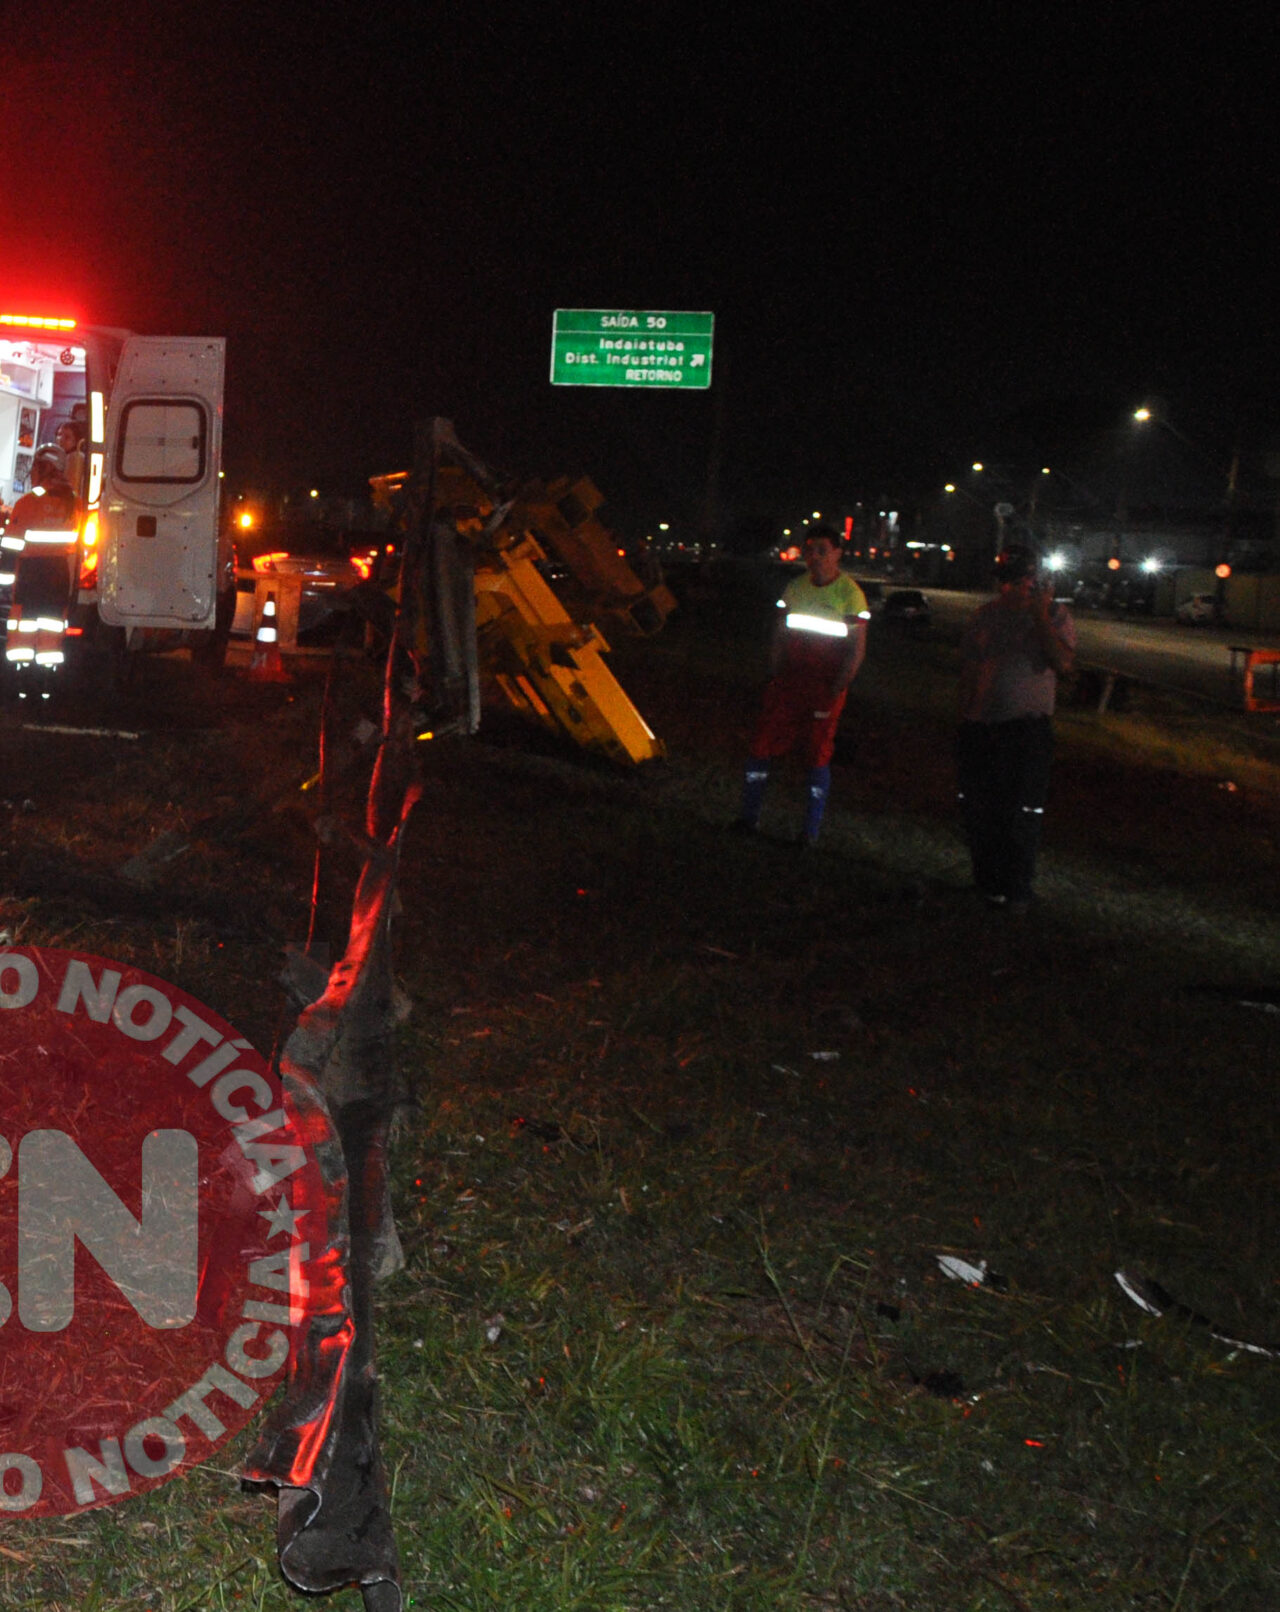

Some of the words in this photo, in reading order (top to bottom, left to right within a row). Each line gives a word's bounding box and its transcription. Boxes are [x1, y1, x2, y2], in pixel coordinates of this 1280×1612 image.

[601, 313, 638, 327] SAÍDA
[646, 317, 667, 328] 50
[600, 338, 684, 351] Indaiatuba
[606, 353, 684, 366] Industrial
[625, 369, 683, 382] RETORNO
